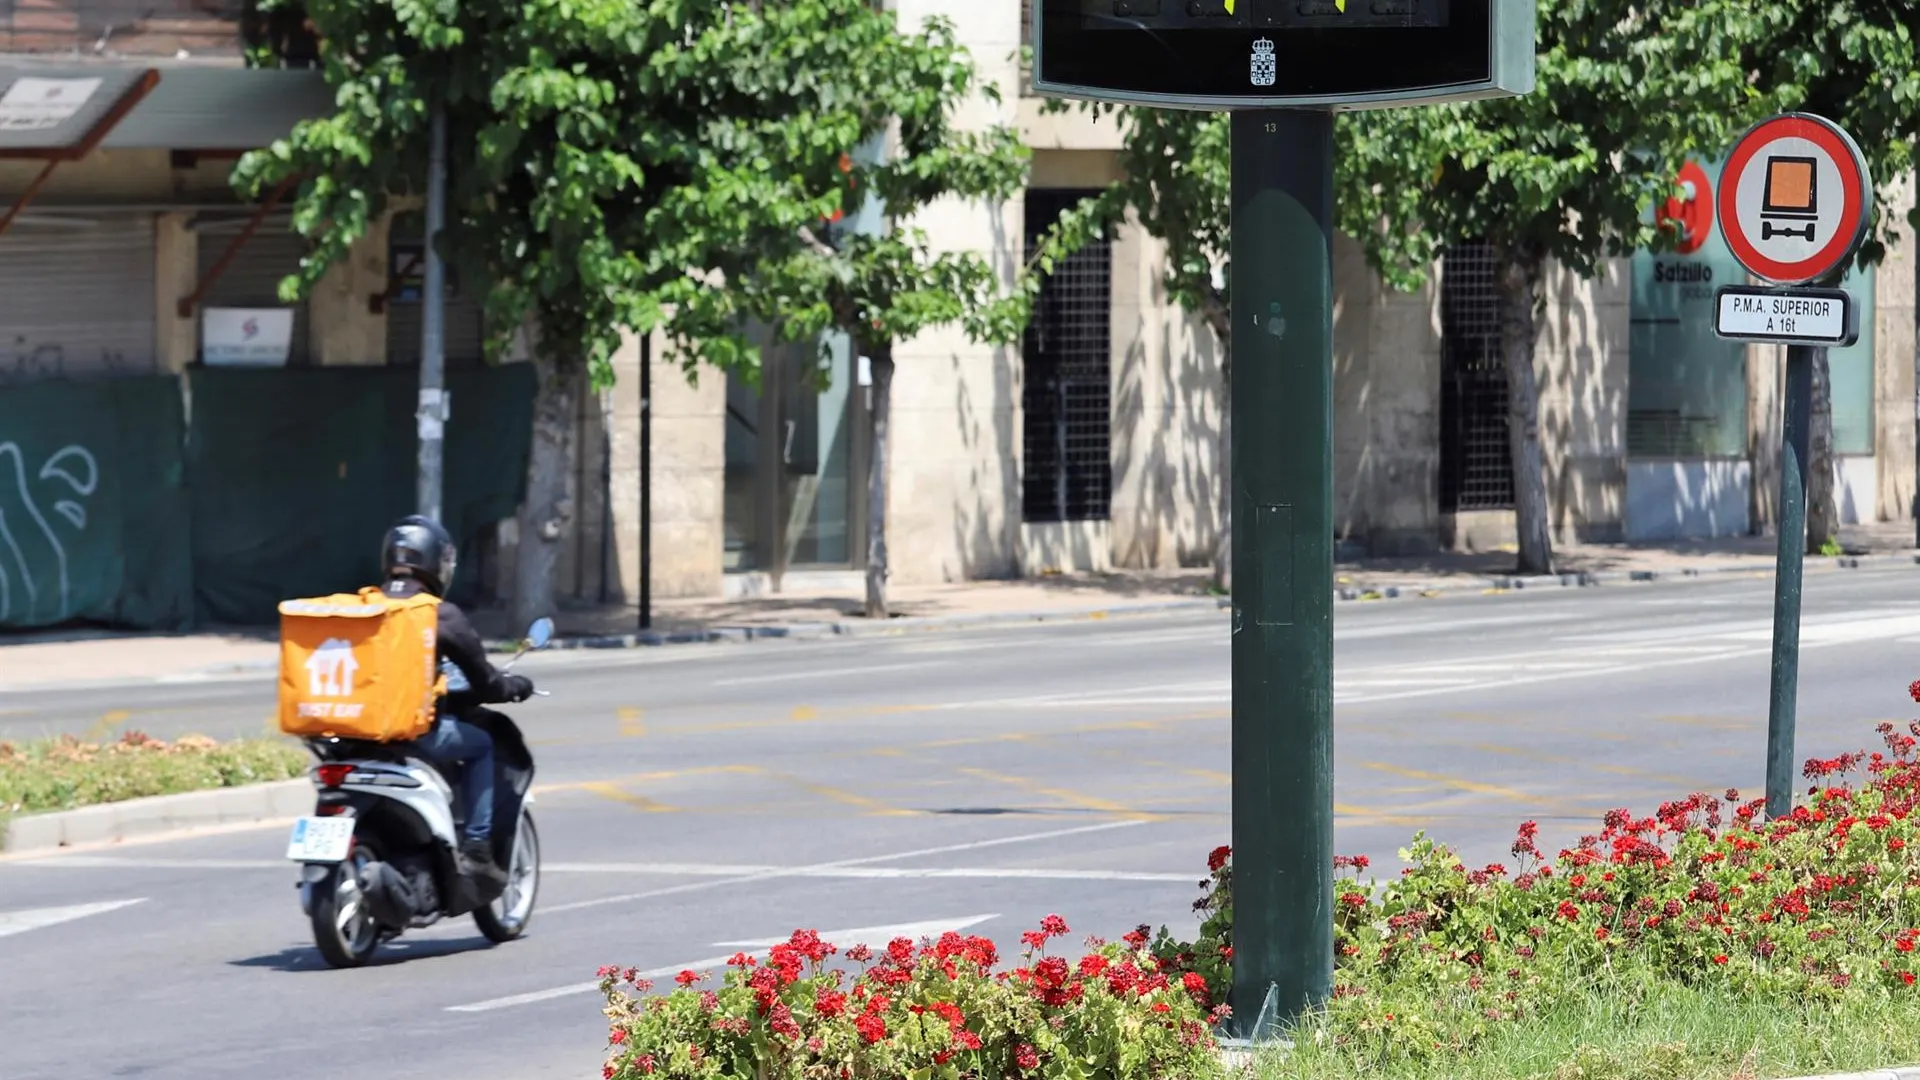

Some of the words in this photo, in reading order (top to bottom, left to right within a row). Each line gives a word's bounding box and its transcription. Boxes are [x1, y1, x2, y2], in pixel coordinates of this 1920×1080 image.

[1264, 123, 1277, 133] 13
[1655, 262, 1712, 283] Salzillo
[1734, 298, 1766, 313] P.M.A.
[1773, 300, 1830, 316] SUPERIOR
[1766, 317, 1774, 331] A
[1780, 318, 1796, 333] 16t
